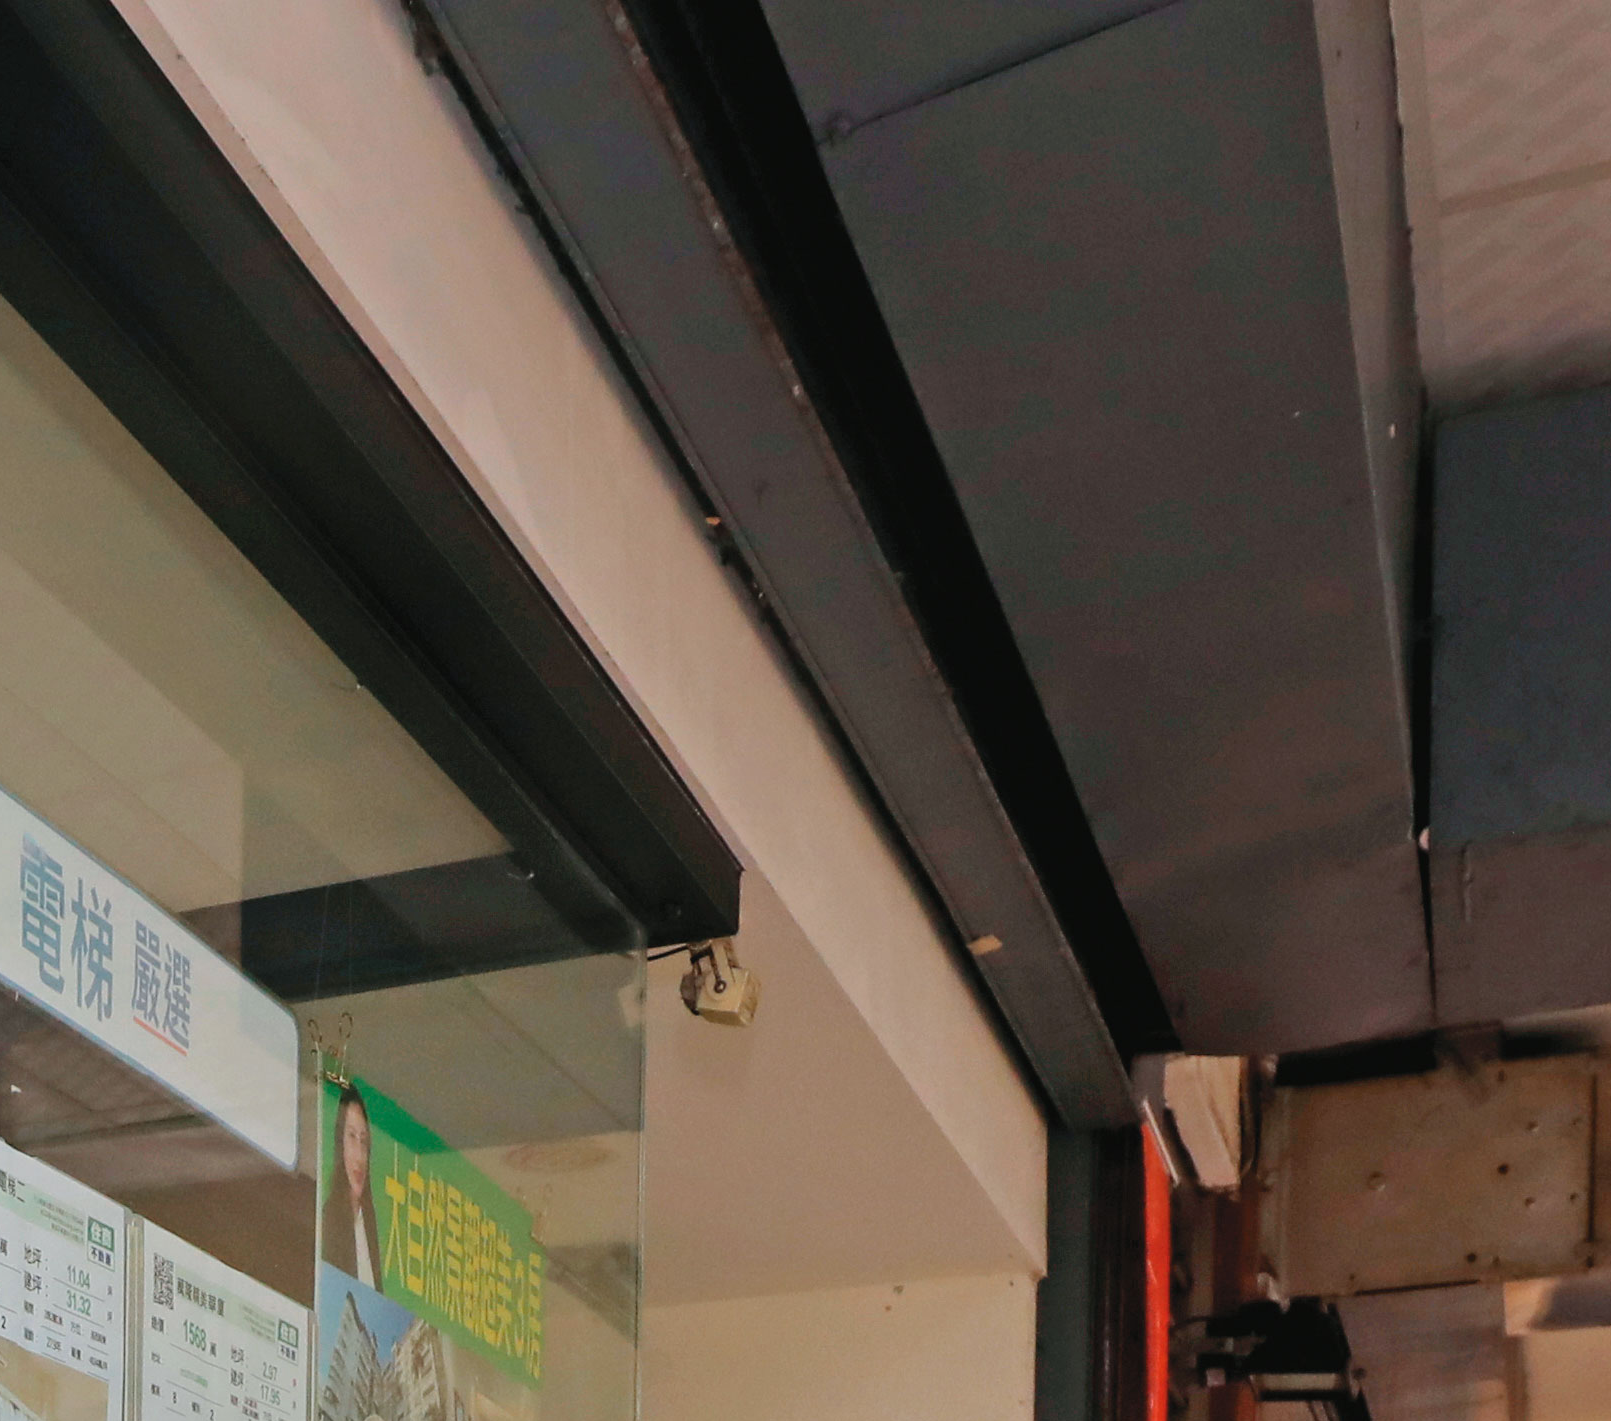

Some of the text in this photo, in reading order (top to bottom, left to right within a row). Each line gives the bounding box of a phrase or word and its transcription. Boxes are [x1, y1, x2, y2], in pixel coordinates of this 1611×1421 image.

[66, 1263, 91, 1290] 11.04
[66, 1289, 92, 1317] 31.32
[182, 1319, 207, 1352] 1568
